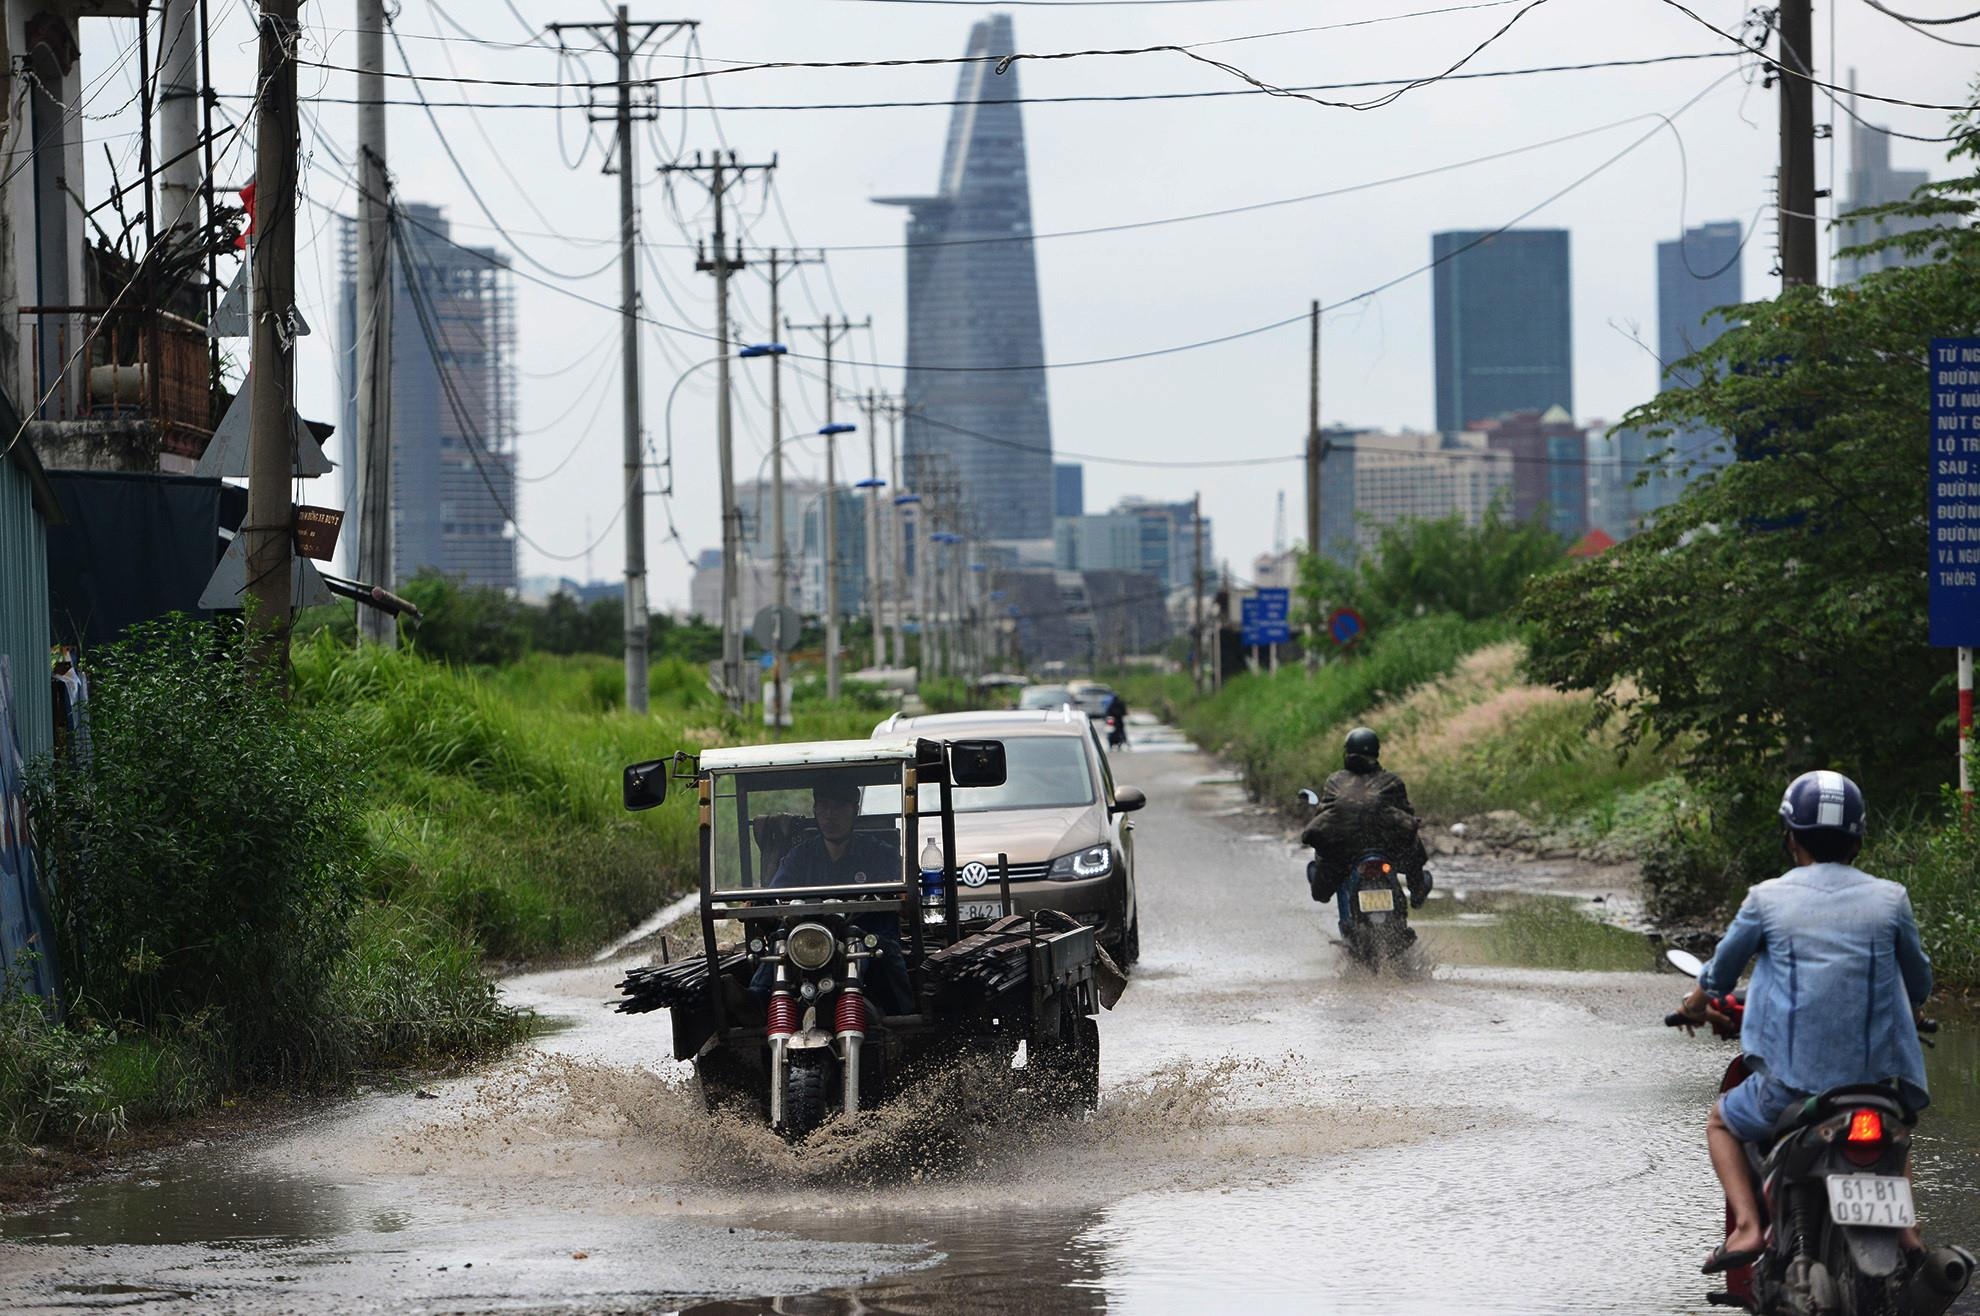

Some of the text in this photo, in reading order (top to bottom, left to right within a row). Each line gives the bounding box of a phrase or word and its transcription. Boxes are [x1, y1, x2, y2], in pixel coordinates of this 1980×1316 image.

[1938, 366, 1980, 385] ĐƯỜN
[1937, 411, 1968, 430] NÚT
[1937, 435, 1956, 456] LỘ
[1938, 460, 1968, 475] SAU
[1937, 478, 1980, 497] ĐƯỜN
[1937, 500, 1980, 520] ĐƯỜN
[1937, 522, 1980, 542] ĐƯỜN
[1938, 544, 1954, 564] VÀ
[1841, 1180, 1897, 1201] 61-B1
[1836, 1201, 1908, 1224] 097.14
